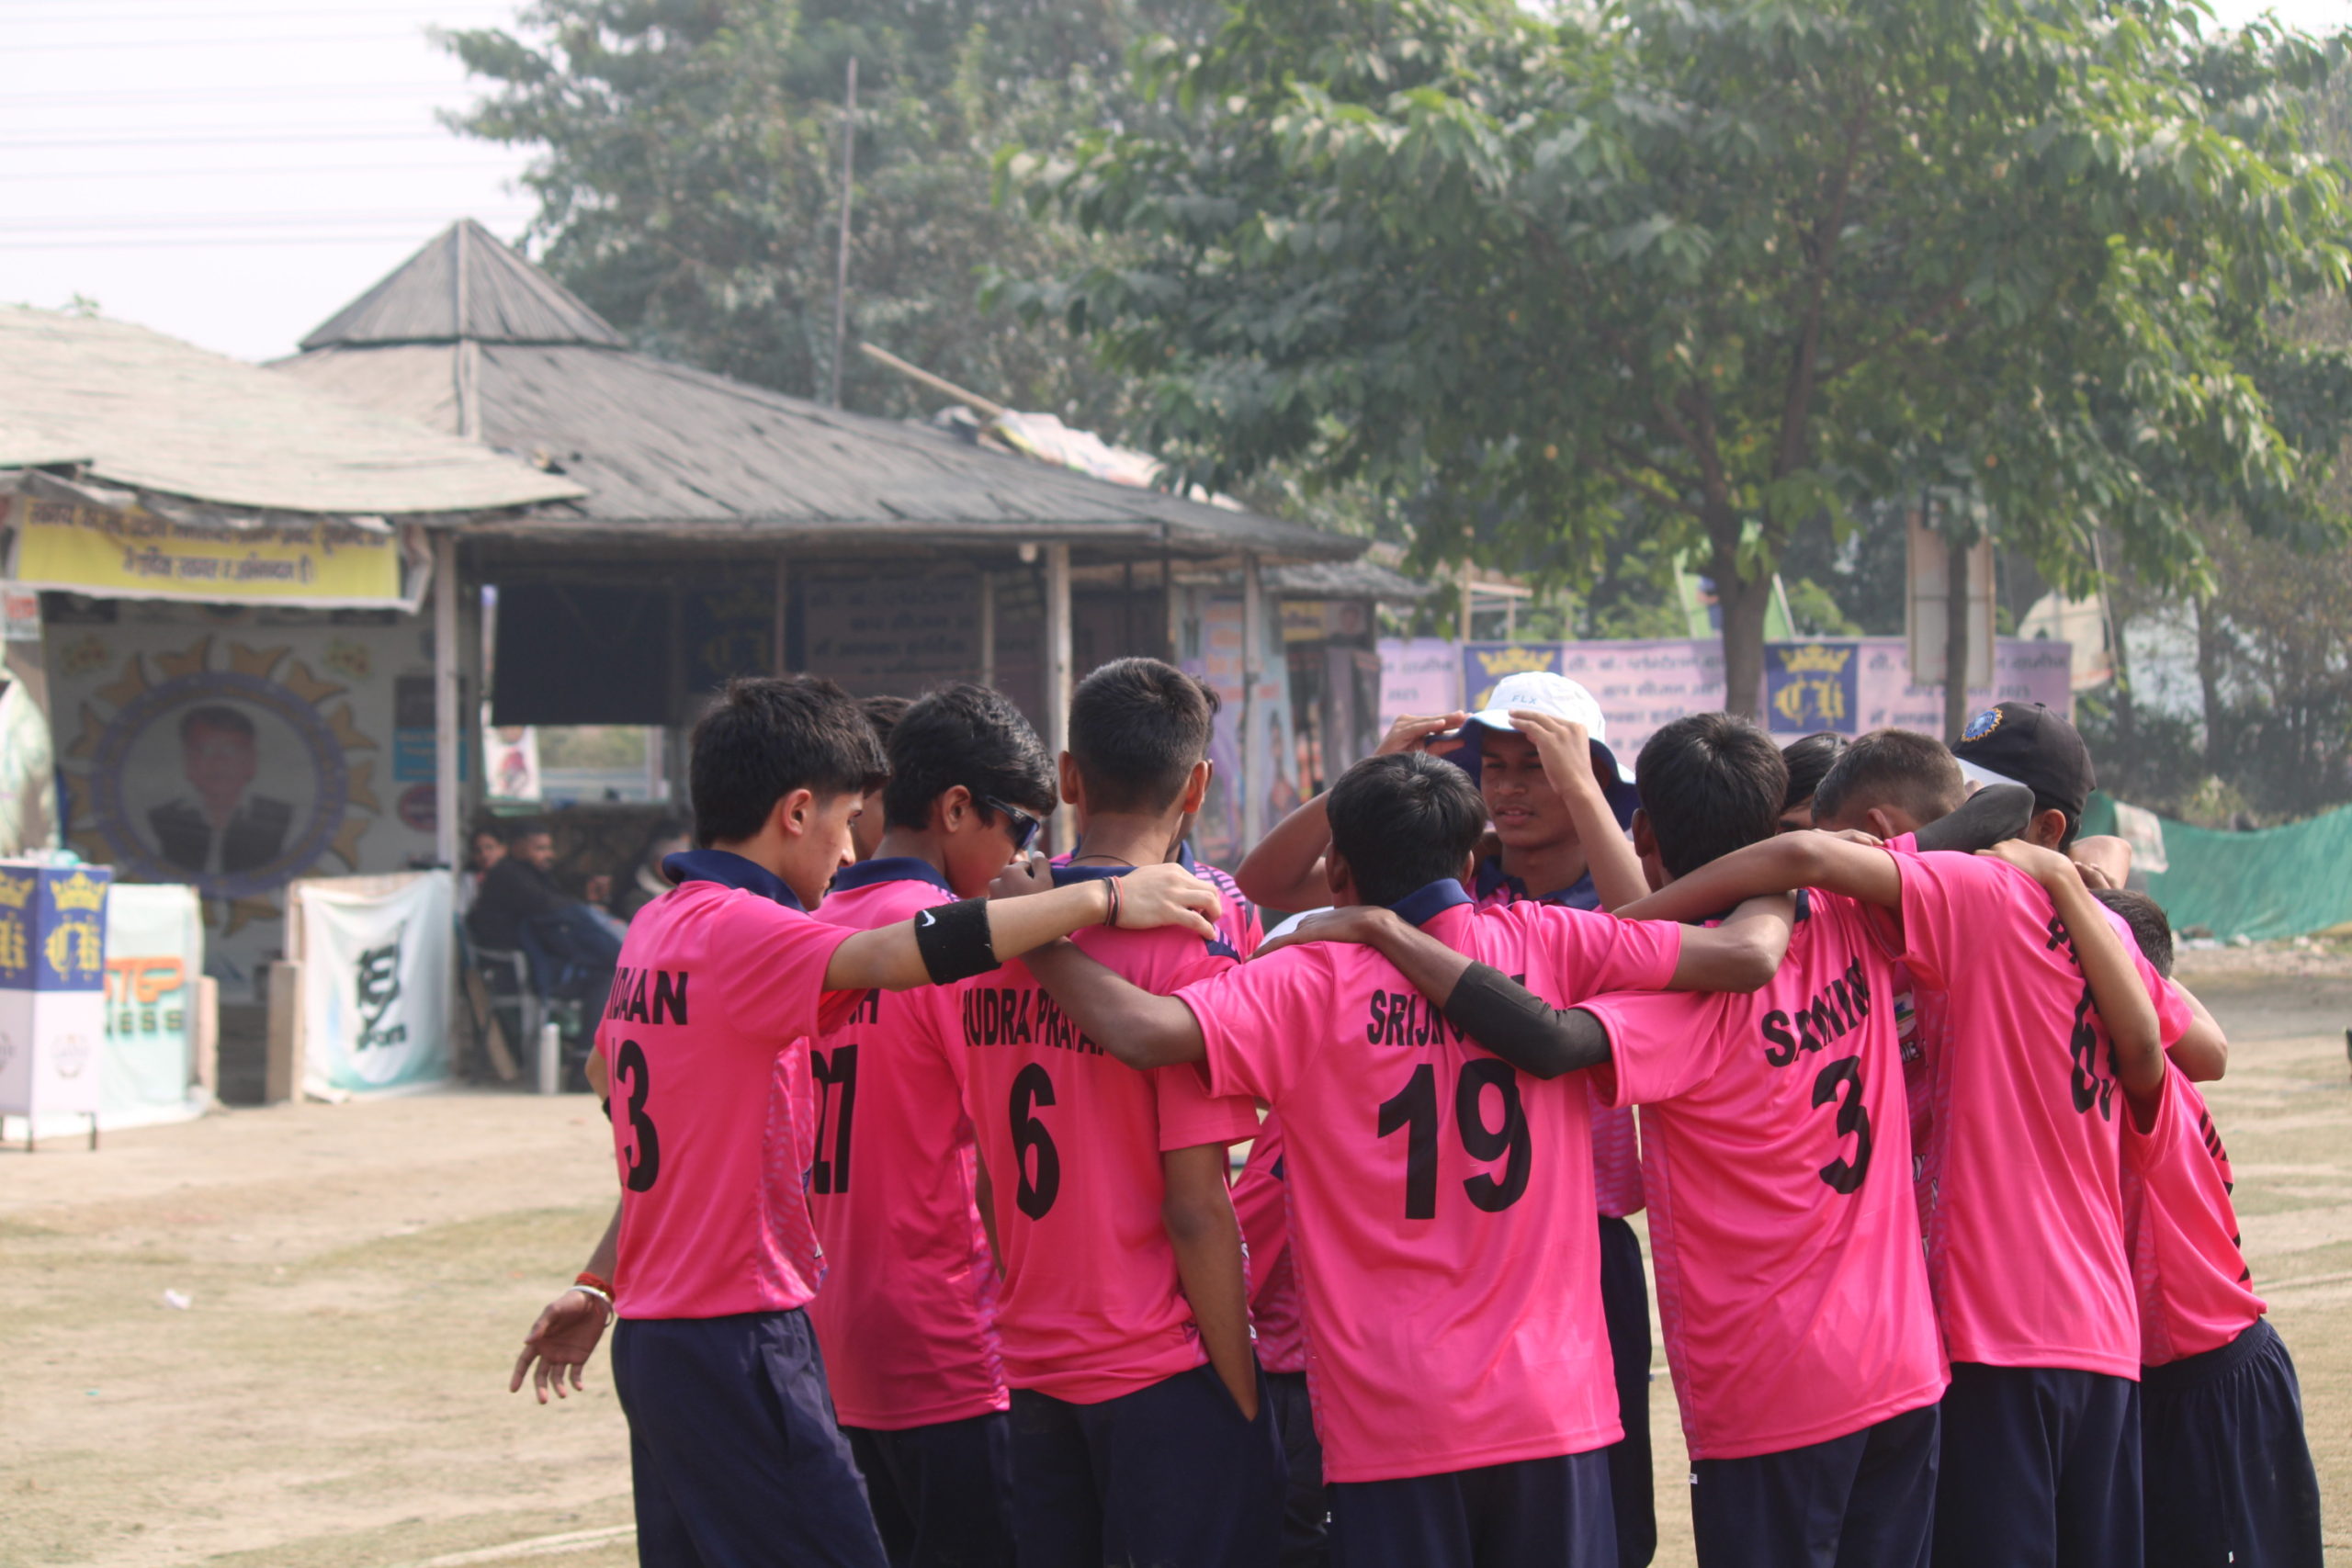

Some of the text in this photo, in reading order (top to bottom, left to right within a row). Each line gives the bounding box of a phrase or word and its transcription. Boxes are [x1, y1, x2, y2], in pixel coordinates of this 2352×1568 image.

[1511, 694, 1537, 705] FLX
[1008, 1062, 1061, 1223] 6
[1377, 1057, 1532, 1220] 19
[1811, 1055, 1872, 1195] 3
